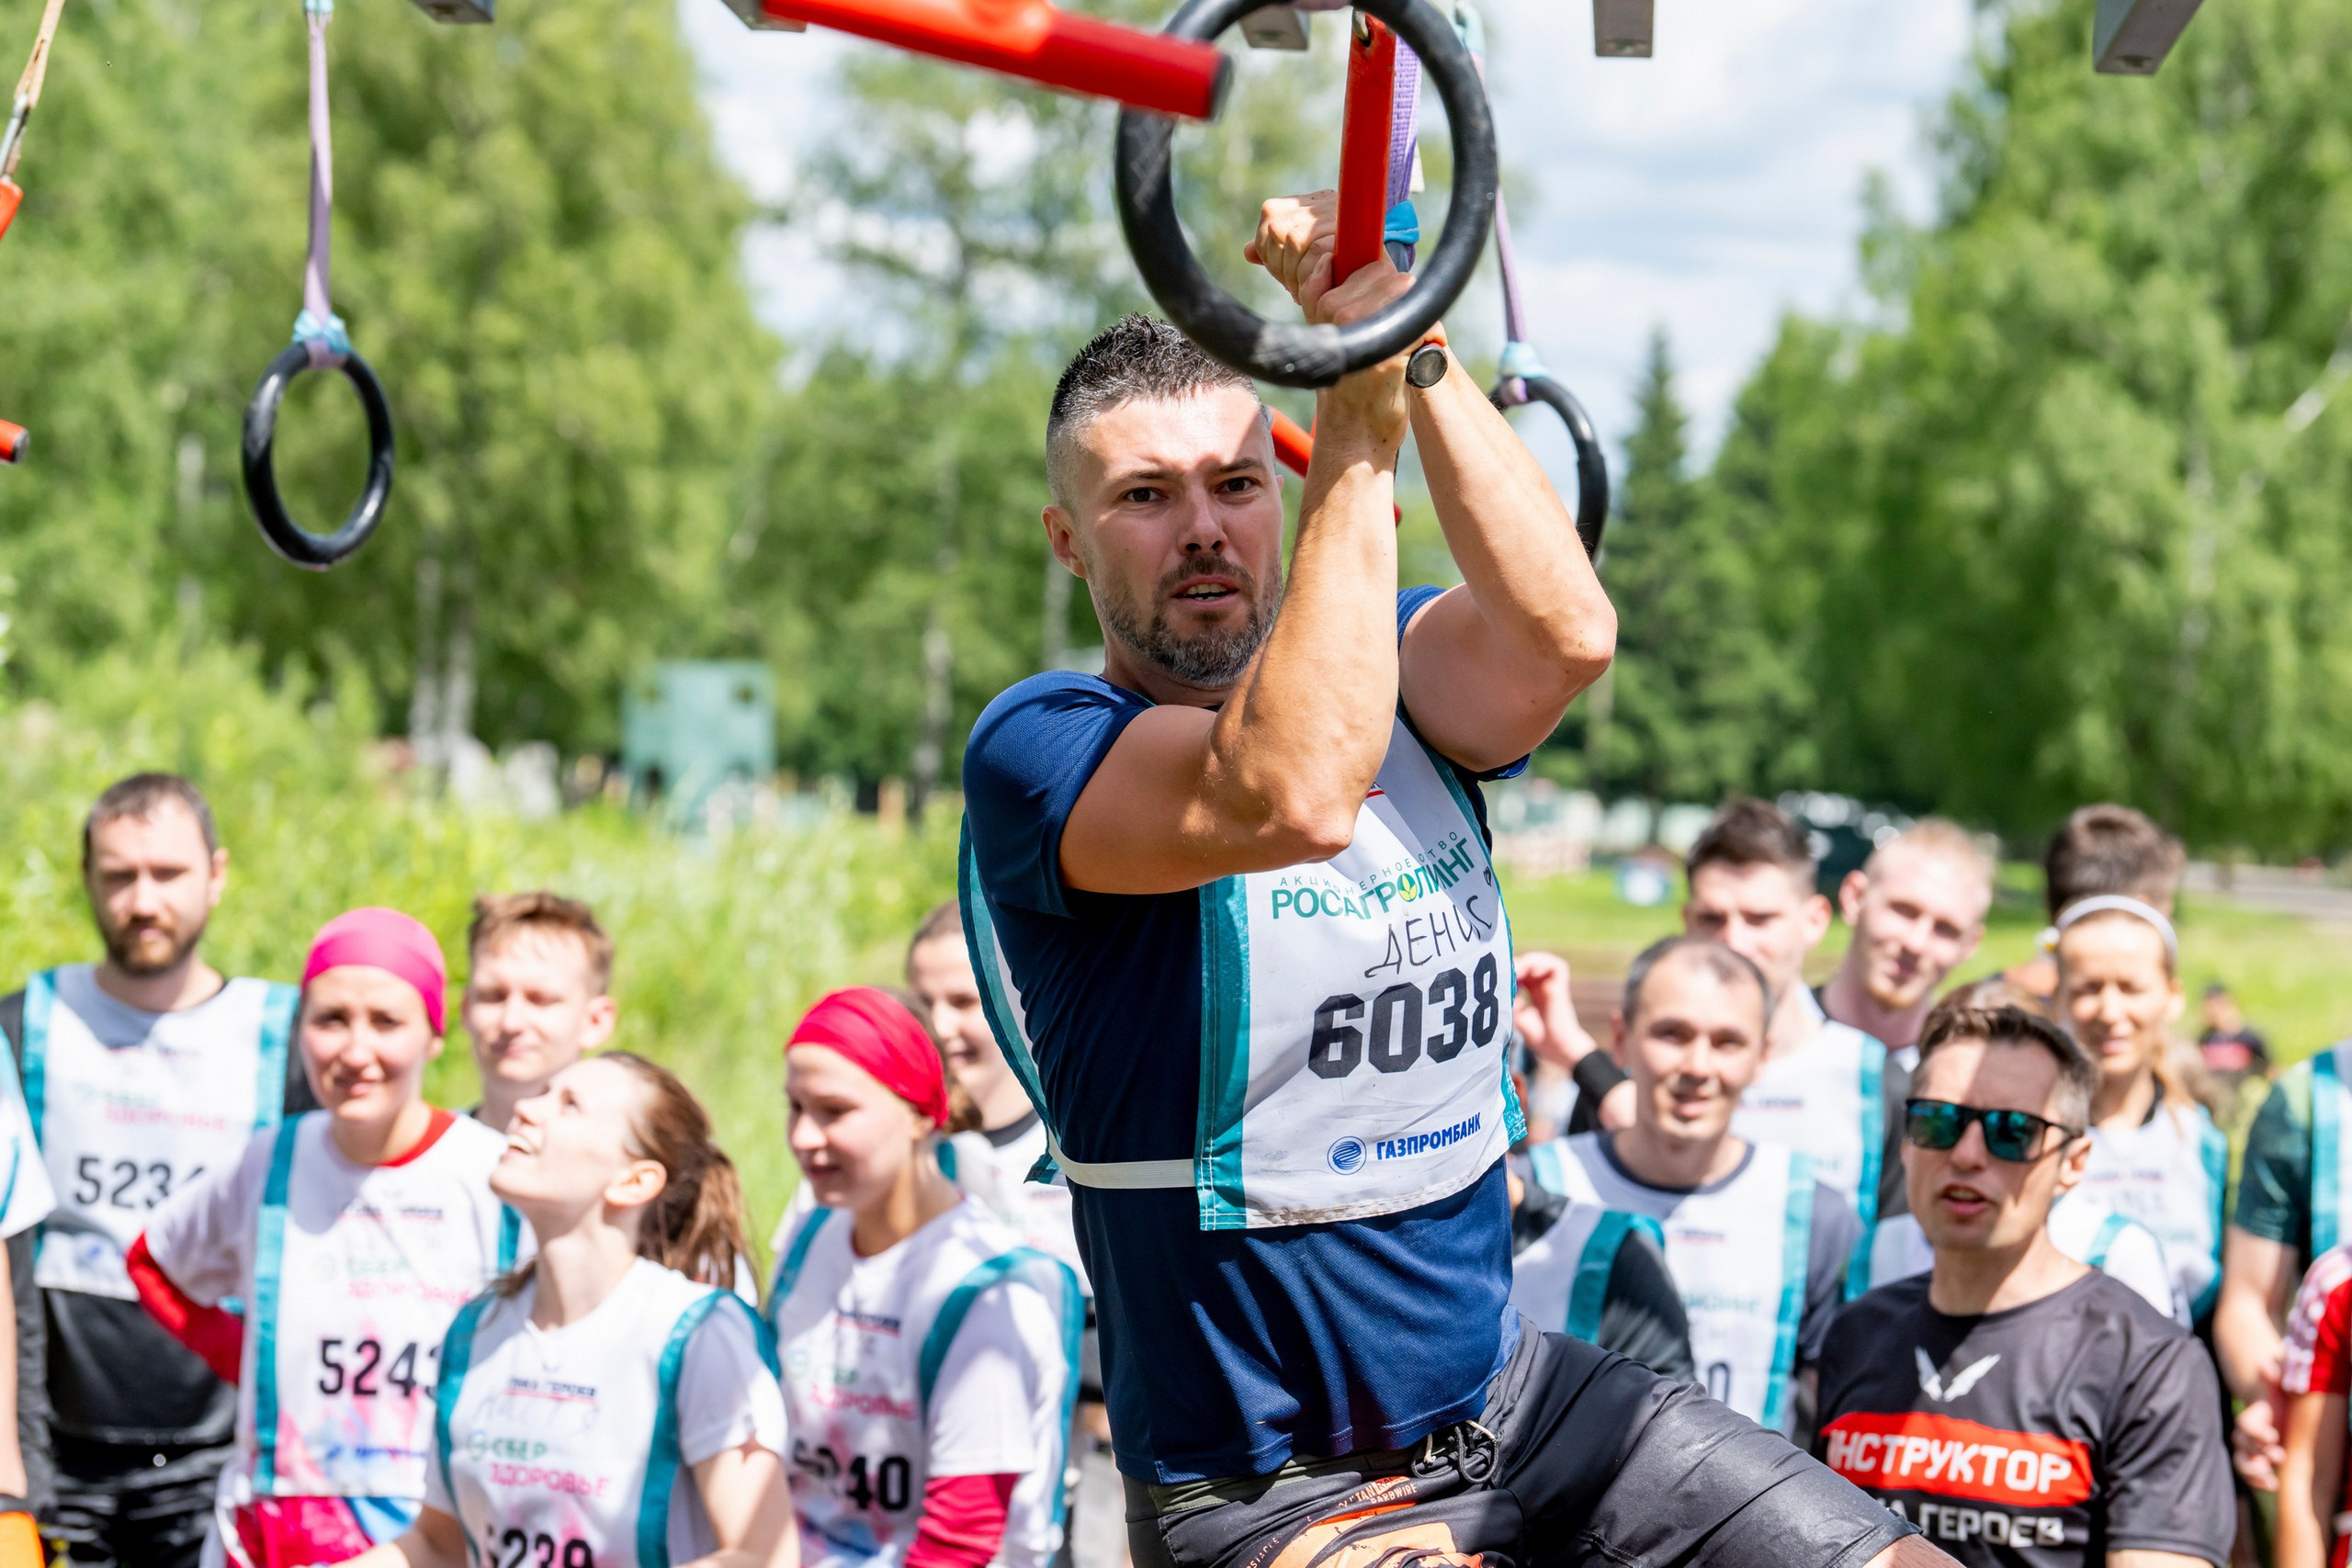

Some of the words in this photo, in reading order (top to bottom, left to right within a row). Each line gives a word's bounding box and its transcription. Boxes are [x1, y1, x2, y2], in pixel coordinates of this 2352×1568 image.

[1271, 837, 1476, 919] РОСАГРОЛИНГ
[1280, 858, 1412, 895] АКЦИОНЕРНОЕ
[1364, 895, 1493, 978] ДЕНИС
[1307, 952, 1499, 1079] 6038
[1377, 1112, 1481, 1160] ГАЗПРОМБАНК
[74, 1156, 206, 1210] 523
[1918, 1502, 2065, 1548] ГЕРОЕВ
